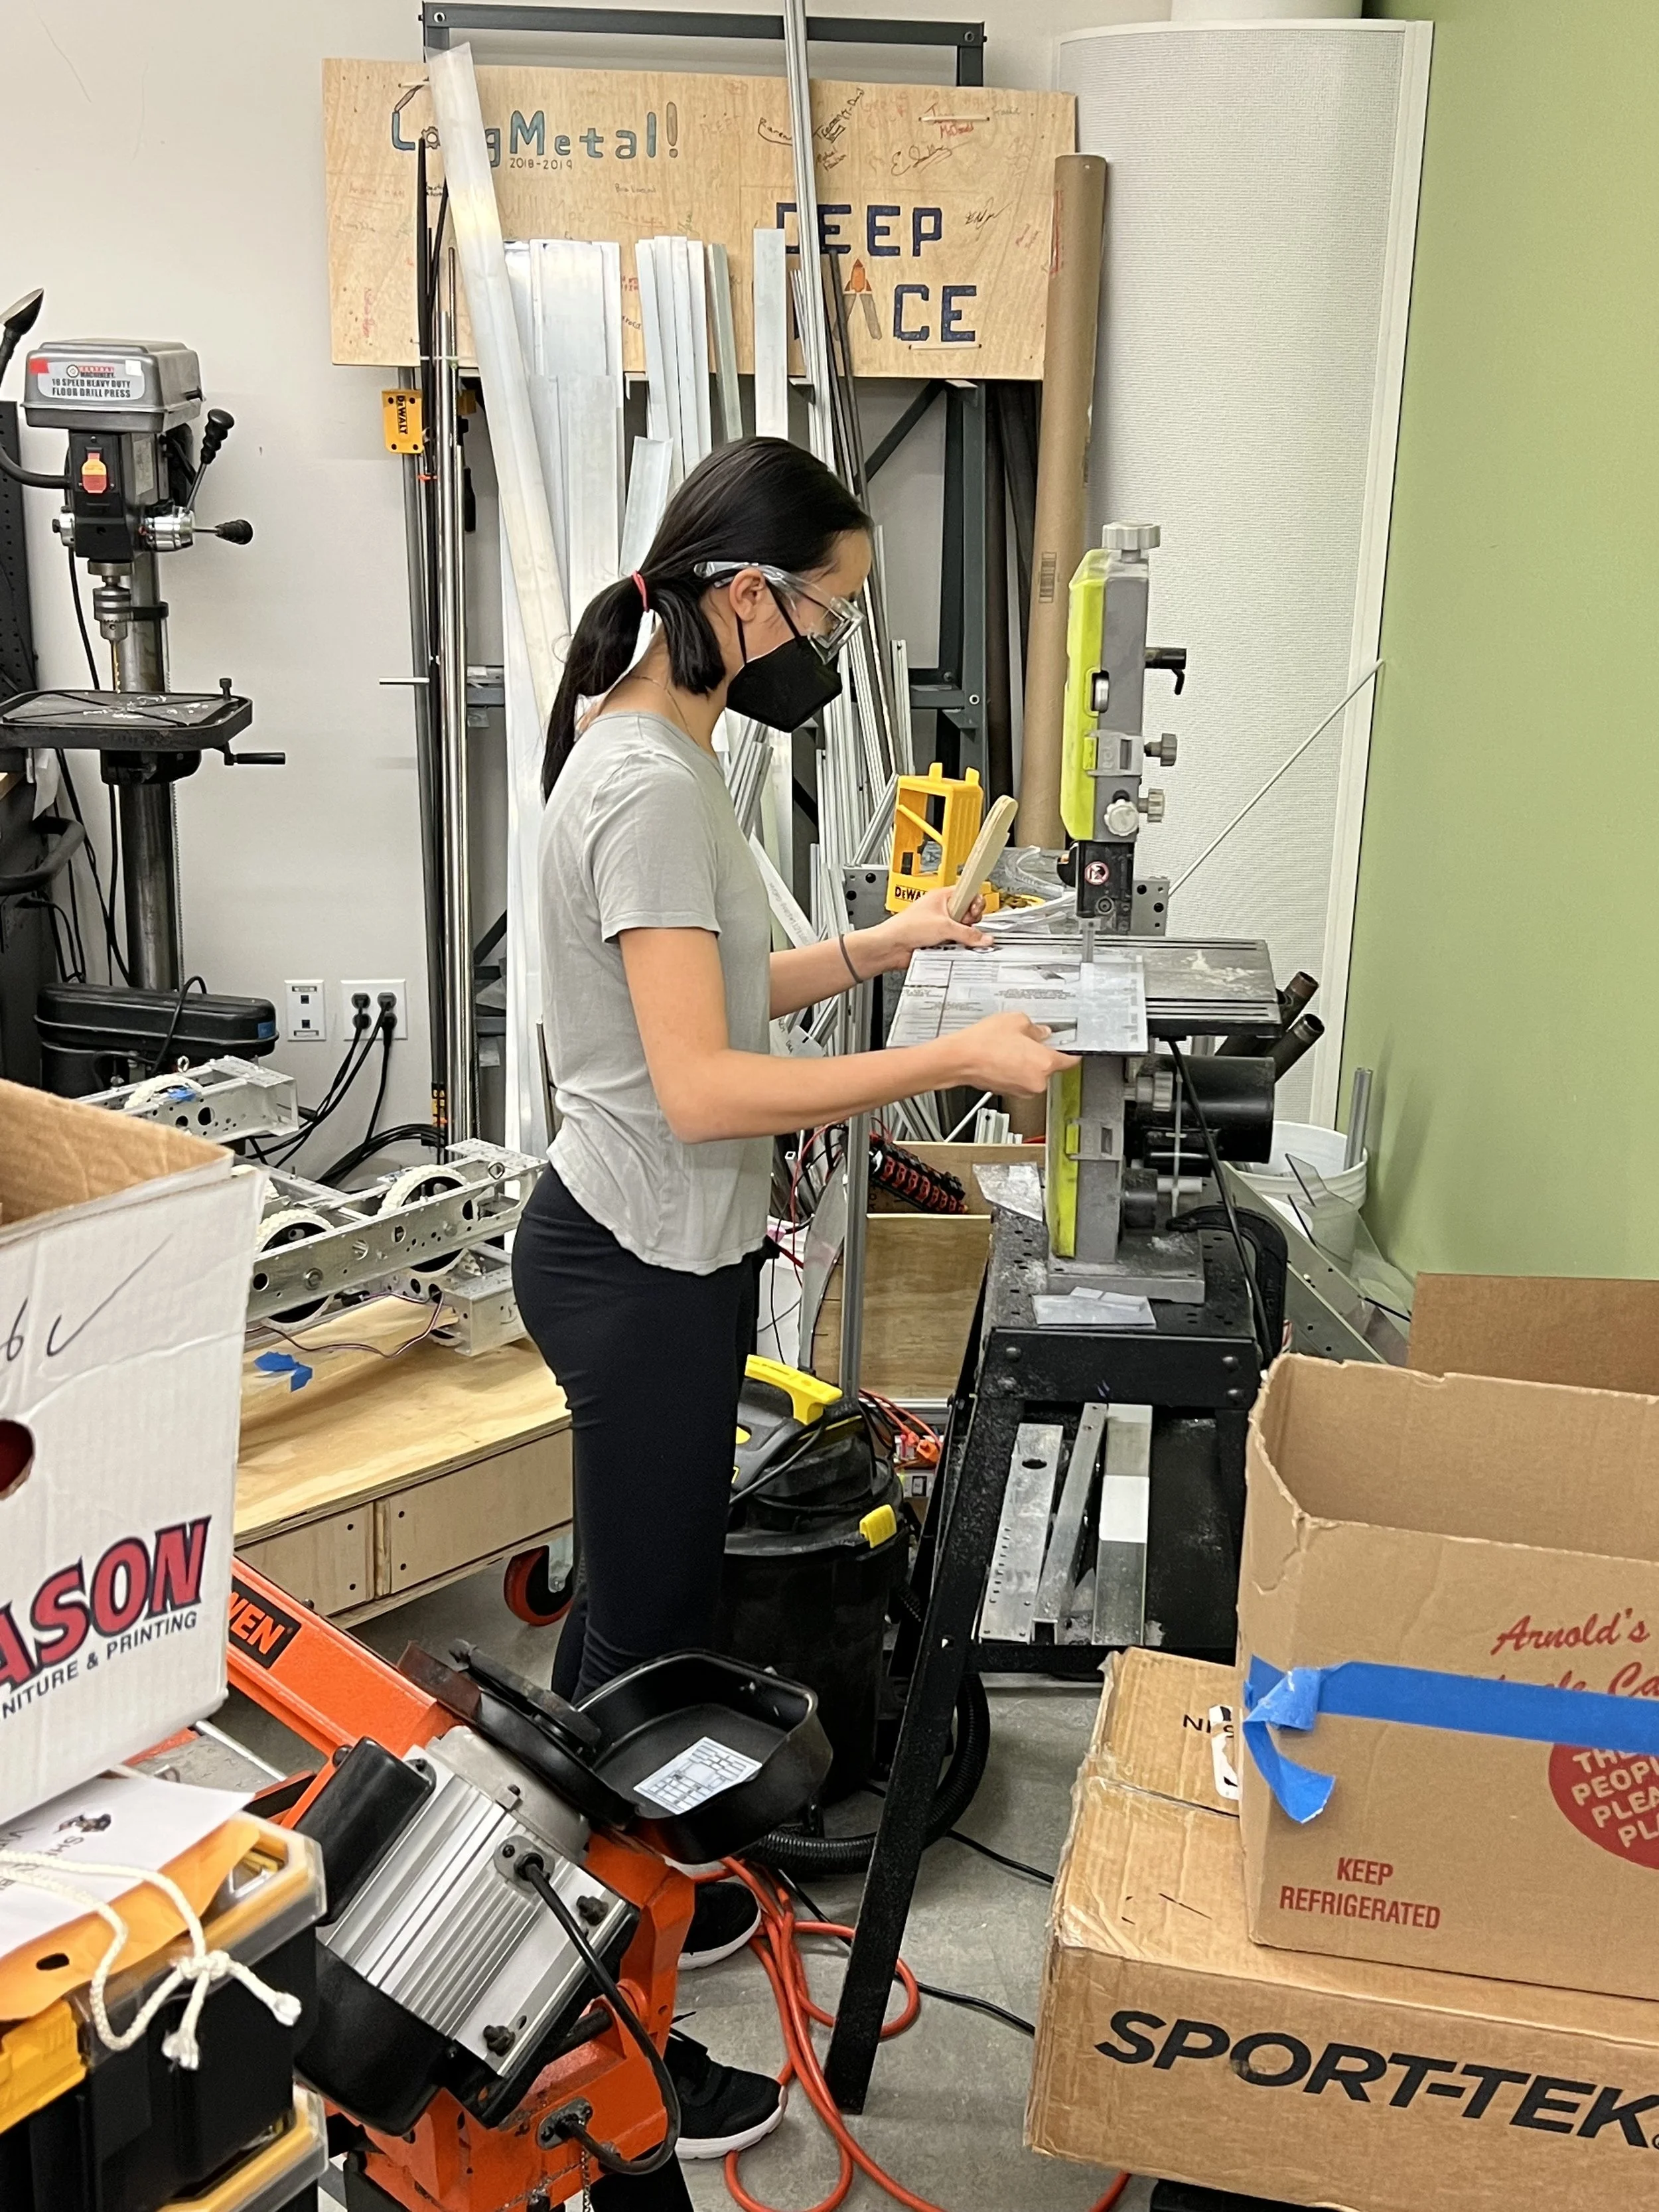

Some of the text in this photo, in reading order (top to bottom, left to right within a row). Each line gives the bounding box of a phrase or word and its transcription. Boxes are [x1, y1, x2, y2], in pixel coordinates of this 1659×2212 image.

[510, 157, 573, 170] 2018-2019
[52, 387, 131, 398] FLOOR DRILL PRESS
[62, 378, 85, 387] SPEED
[86, 379, 109, 388] HEAVY
[86, 1651, 100, 1670] &
[106, 1611, 198, 1660] PRINTING
[1490, 1608, 1650, 1656] Arnold's
[1618, 1813, 1659, 1848] PL
[1336, 1857, 1394, 1886] KEEP
[1279, 1885, 1441, 1930] REFRIGERATED
